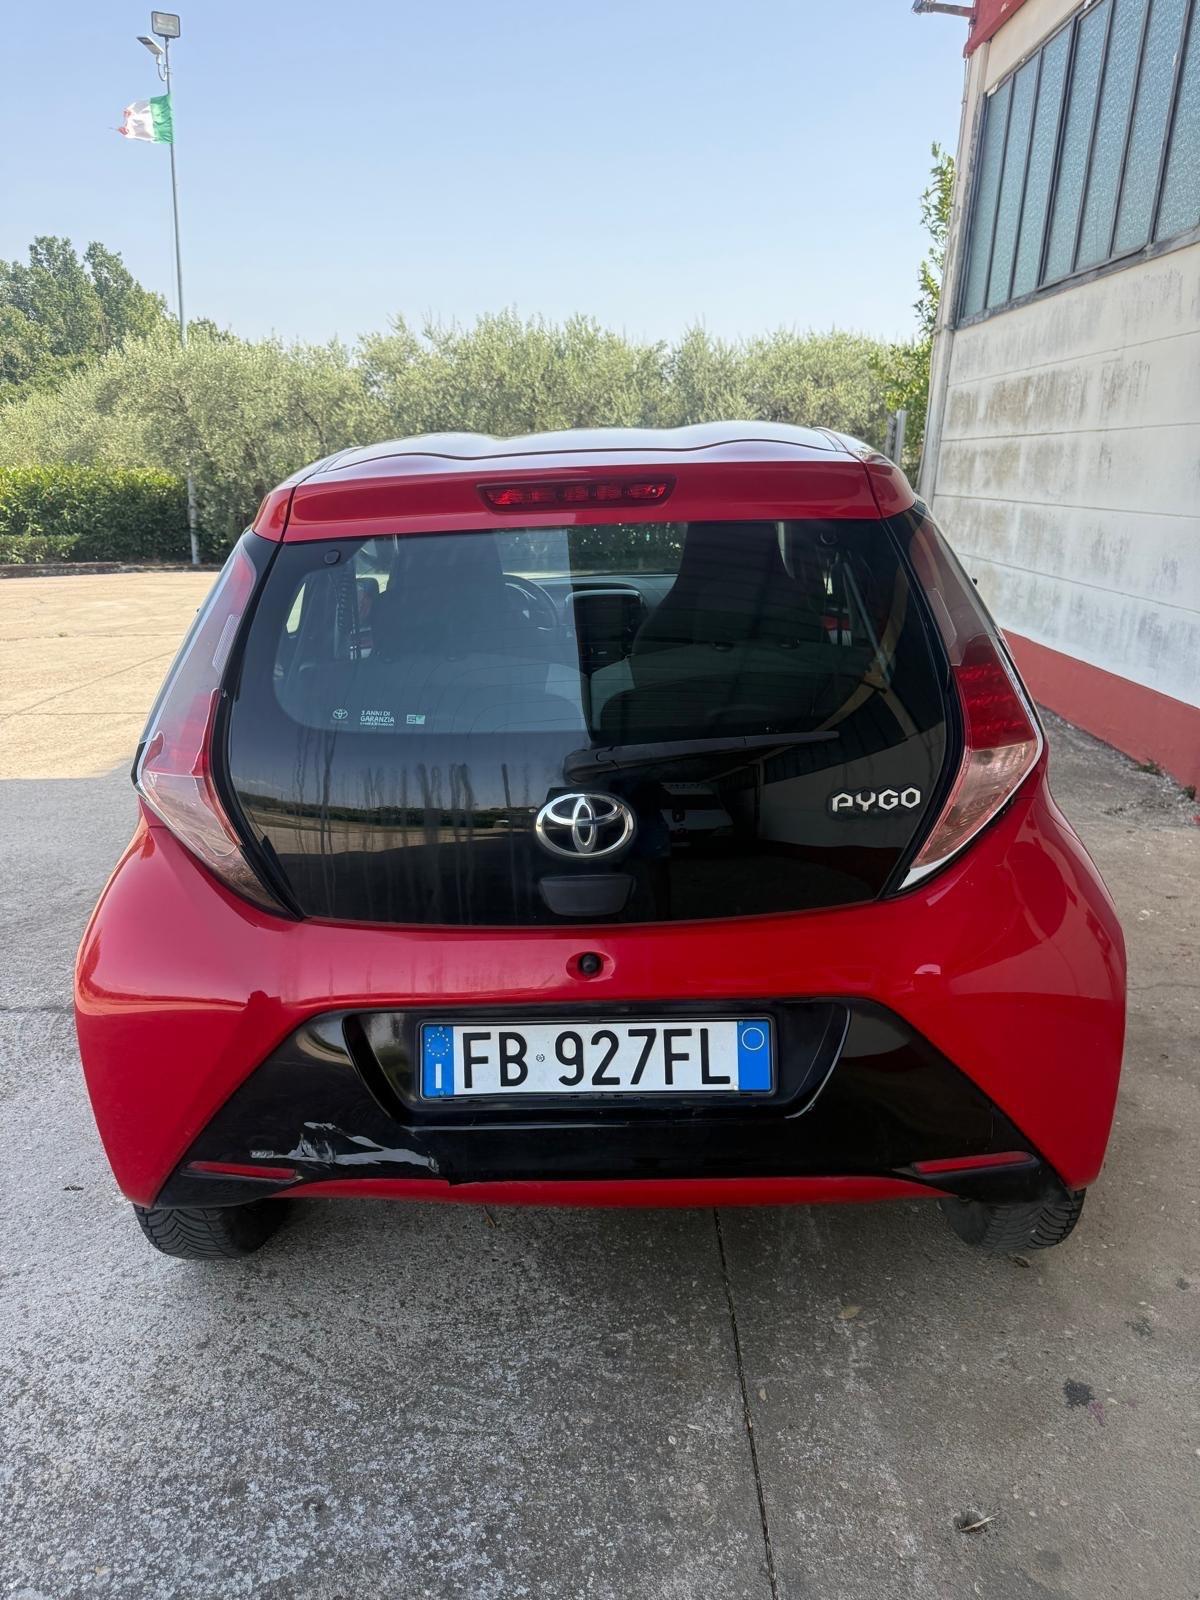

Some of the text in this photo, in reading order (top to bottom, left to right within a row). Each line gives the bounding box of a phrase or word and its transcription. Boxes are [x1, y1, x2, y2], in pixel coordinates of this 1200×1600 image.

[360, 715, 394, 723] GARANZIA
[462, 1028, 731, 1089] FB 927FL
[435, 1063, 442, 1088] I
